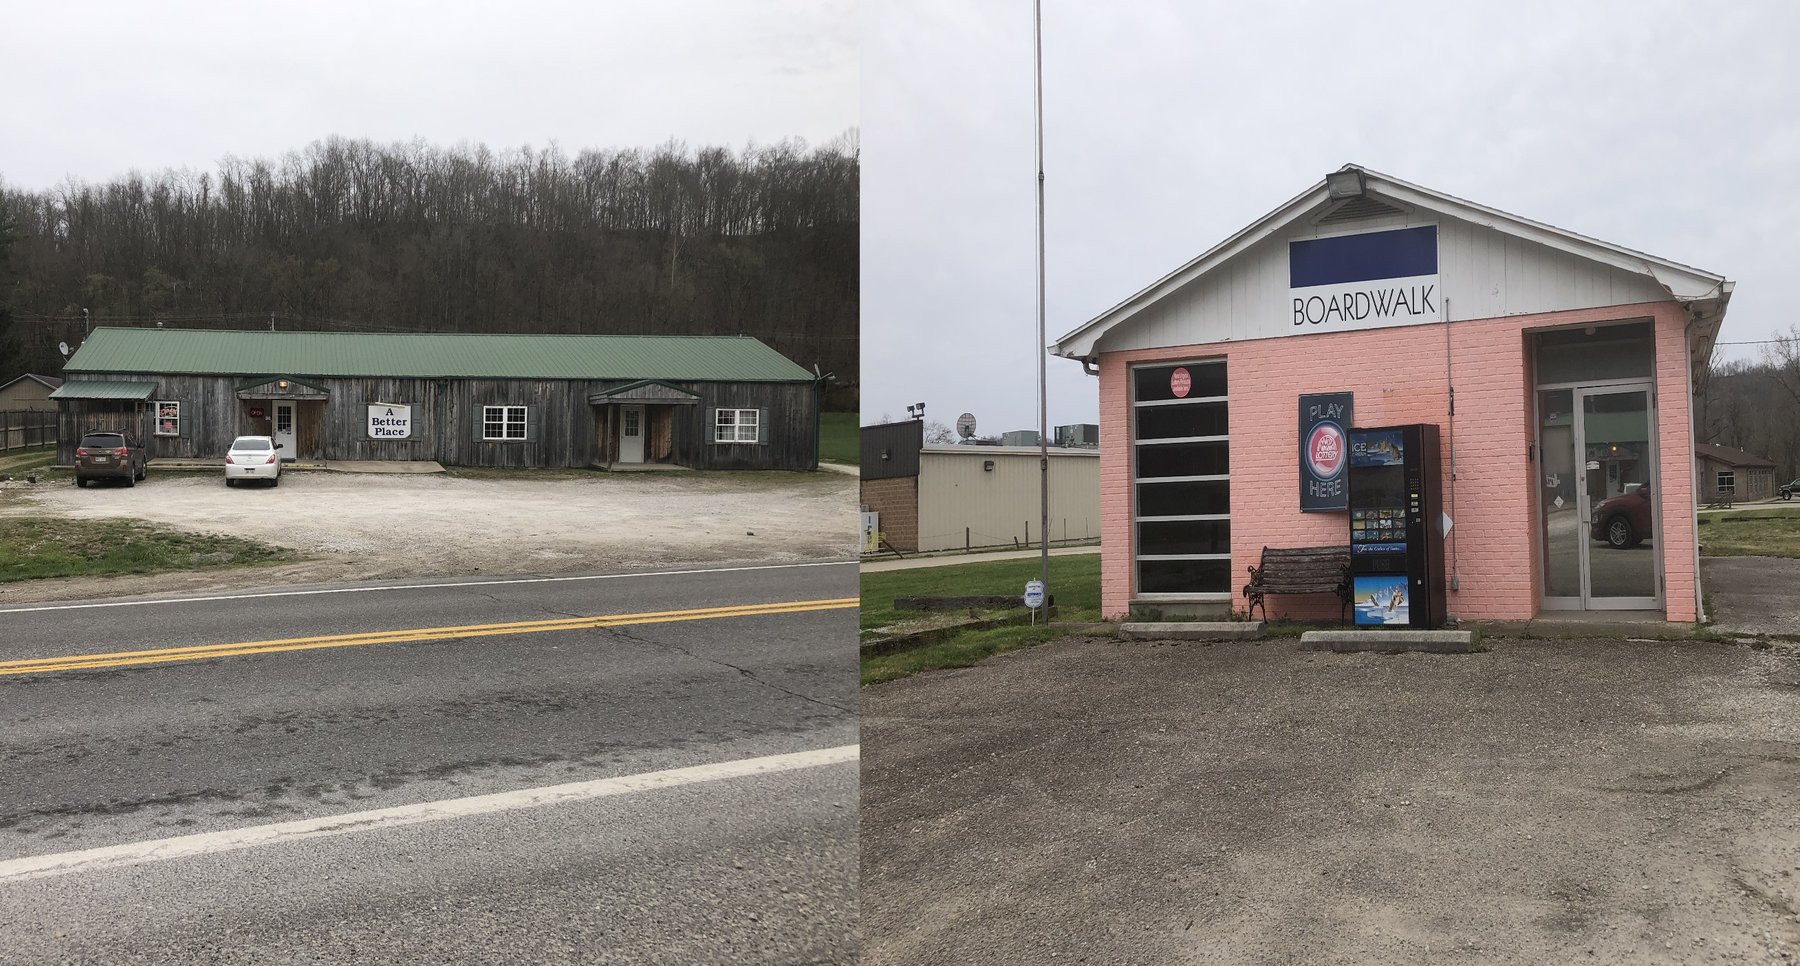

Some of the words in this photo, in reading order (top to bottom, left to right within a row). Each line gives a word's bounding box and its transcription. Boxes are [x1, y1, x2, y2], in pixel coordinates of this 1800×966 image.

[1293, 284, 1436, 326] BOARDWALK
[385, 407, 394, 416] A
[1309, 402, 1344, 421] PLAY
[371, 417, 408, 426] Better
[374, 427, 405, 436] Place
[1351, 442, 1367, 452] ICE
[1315, 450, 1339, 460] LOTTERY
[1309, 479, 1342, 498] HERE
